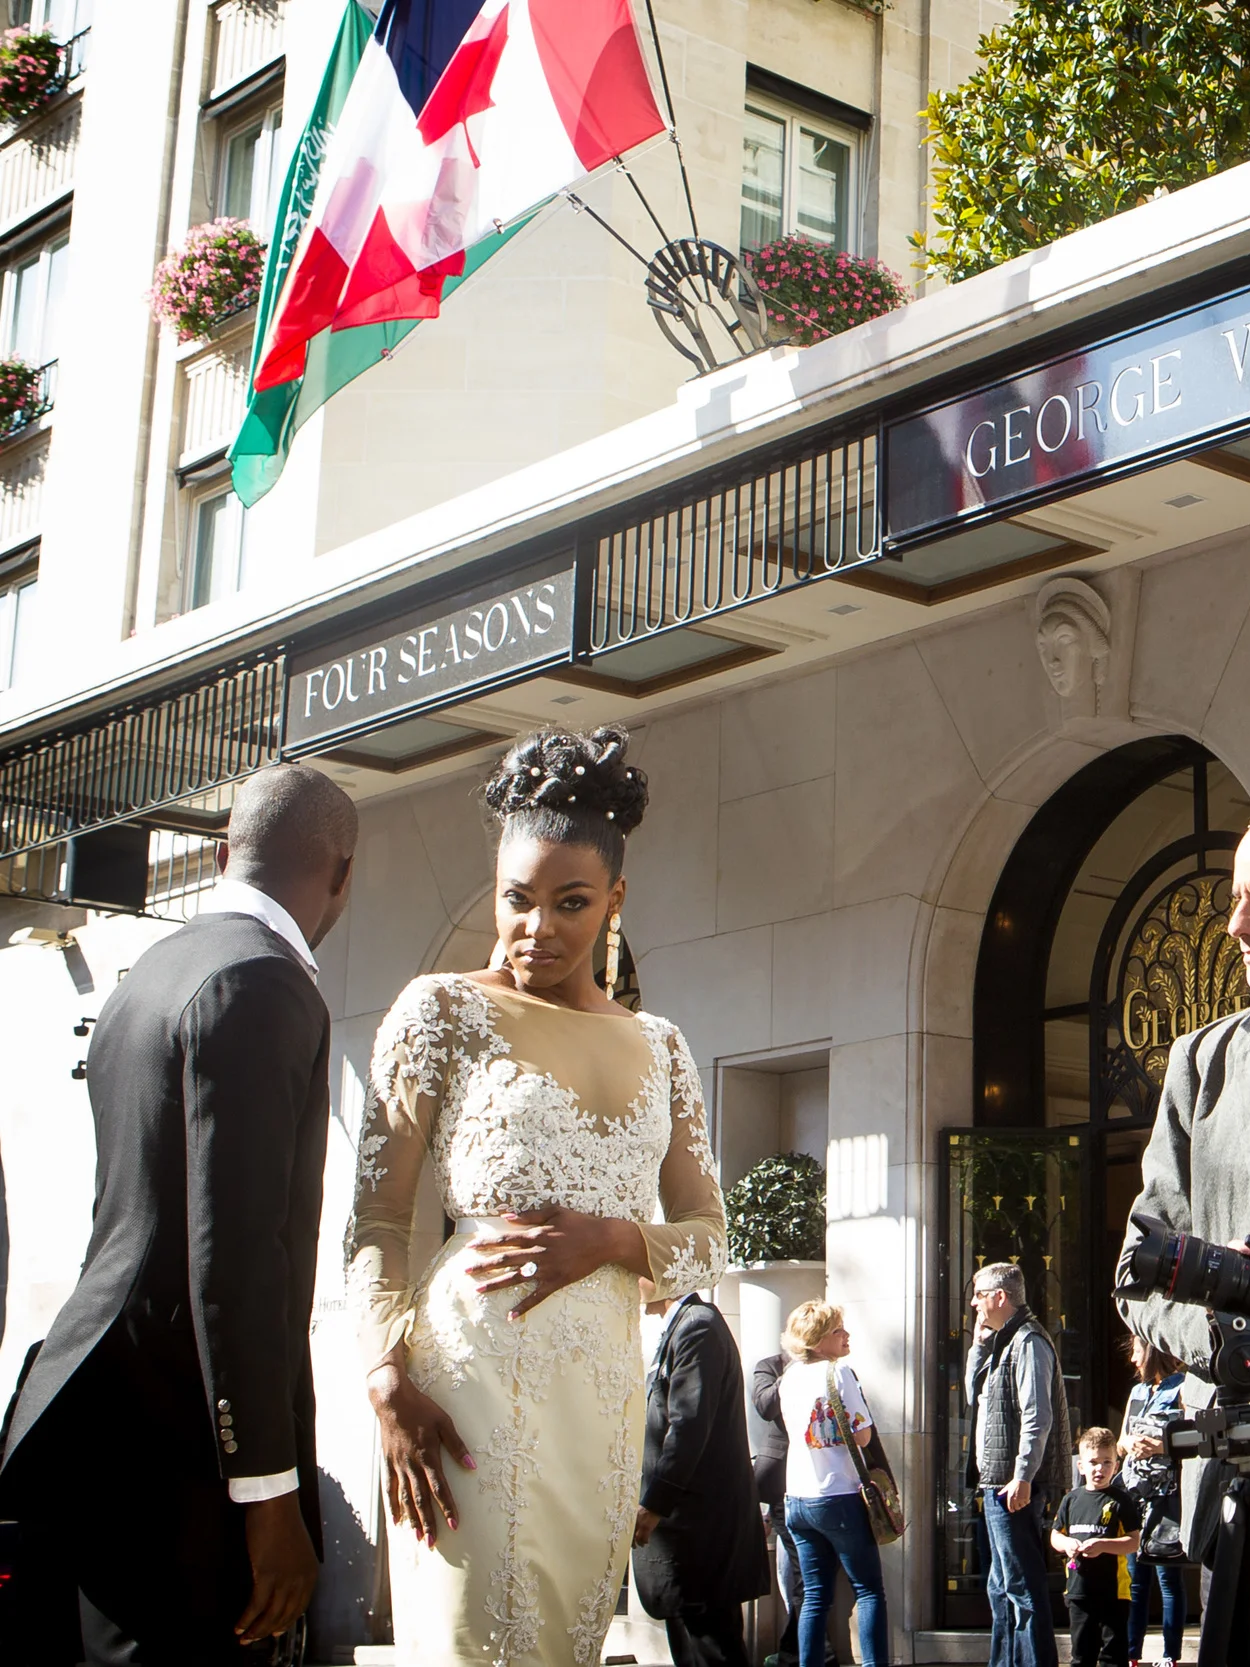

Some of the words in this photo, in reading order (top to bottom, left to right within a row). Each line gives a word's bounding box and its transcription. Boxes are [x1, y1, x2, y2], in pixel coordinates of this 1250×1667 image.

[966, 348, 1182, 477] GEORGE
[304, 646, 387, 717] FOUR
[397, 584, 555, 684] SEASONS
